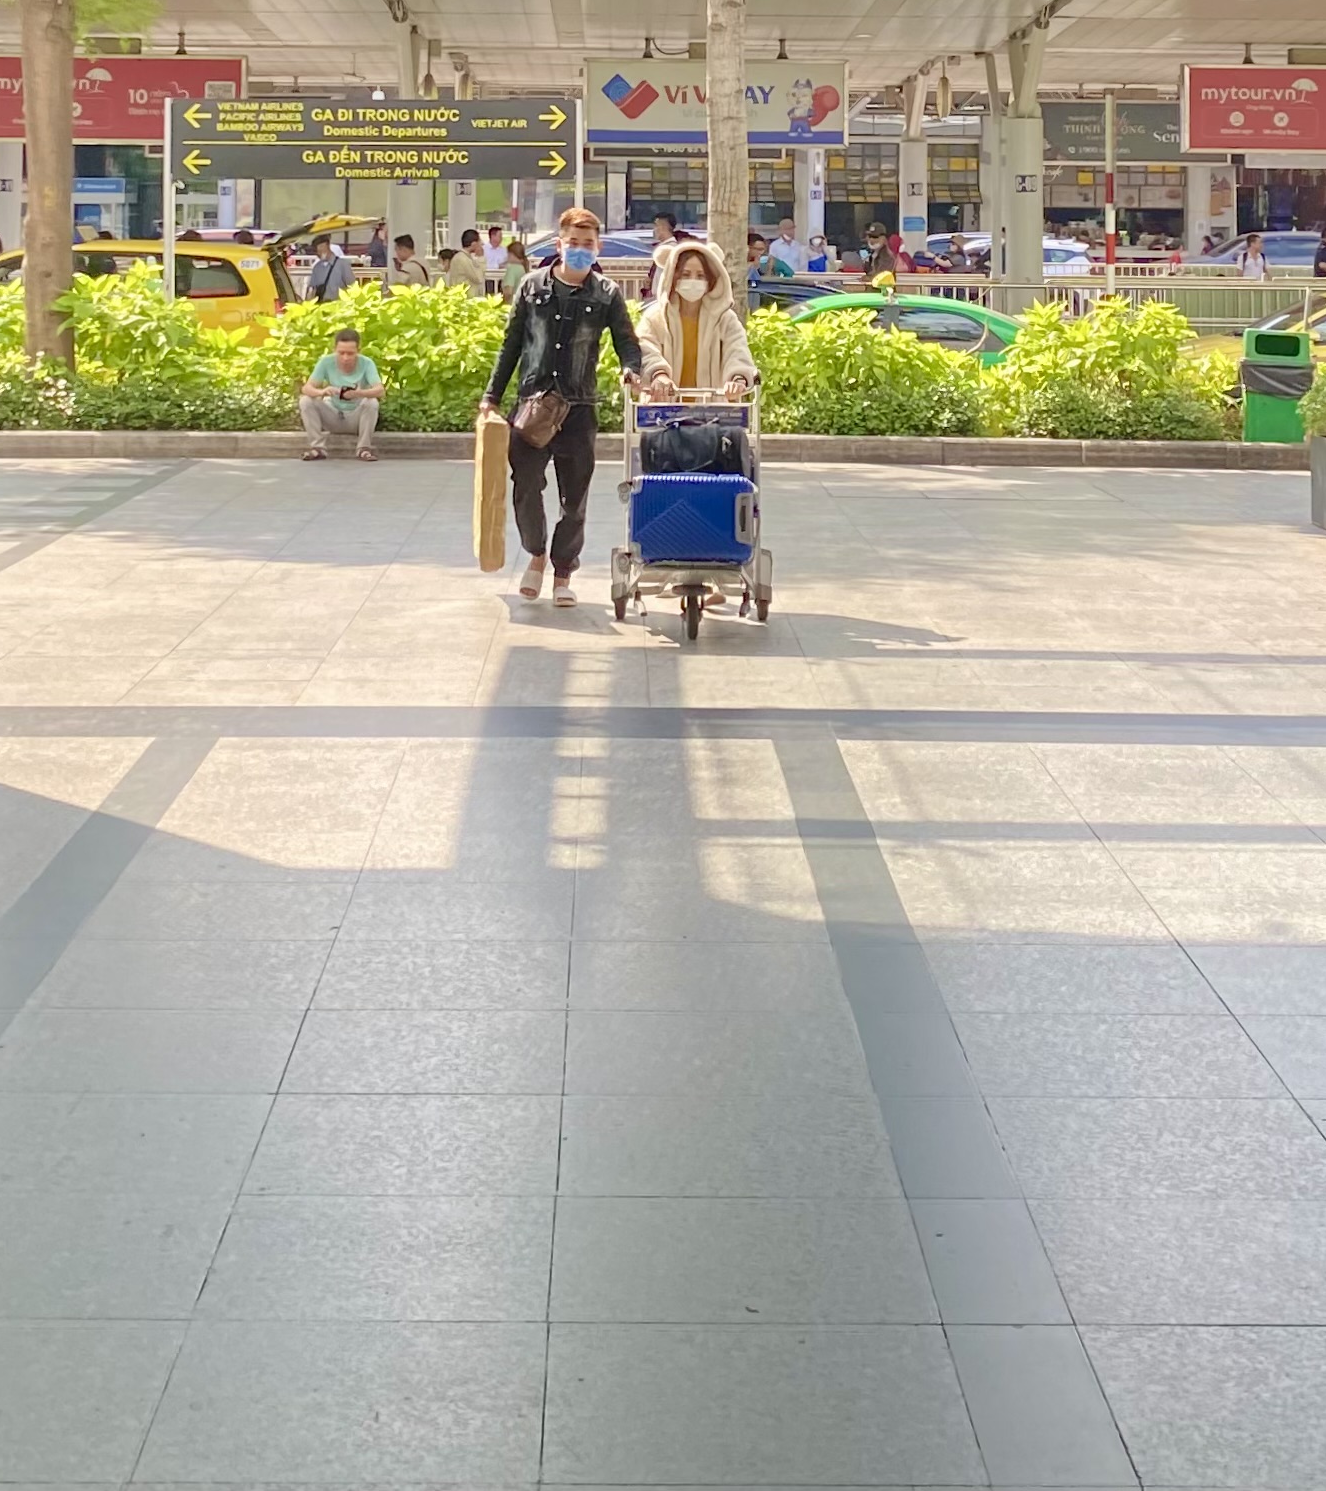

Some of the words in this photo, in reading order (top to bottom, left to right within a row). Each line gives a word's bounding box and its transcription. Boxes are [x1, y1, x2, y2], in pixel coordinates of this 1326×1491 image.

[127, 88, 148, 104] 10
[1201, 86, 1296, 104] mytour.vn
[219, 112, 257, 122] PACIFIC
[311, 109, 335, 122] GA
[337, 109, 353, 122] ĐI
[354, 109, 410, 122] TRONG
[414, 107, 460, 122] NƯỚC
[471, 119, 509, 128] VIETJET
[510, 119, 528, 128] AIR
[323, 125, 381, 137] Domestic
[382, 125, 448, 139] Departures
[302, 150, 325, 164] GA
[329, 145, 361, 164] ĐẾN
[364, 150, 419, 164] TRONG
[422, 148, 469, 164] NƯỚC
[335, 167, 391, 178] Domestic
[393, 167, 440, 178] Arrivals
